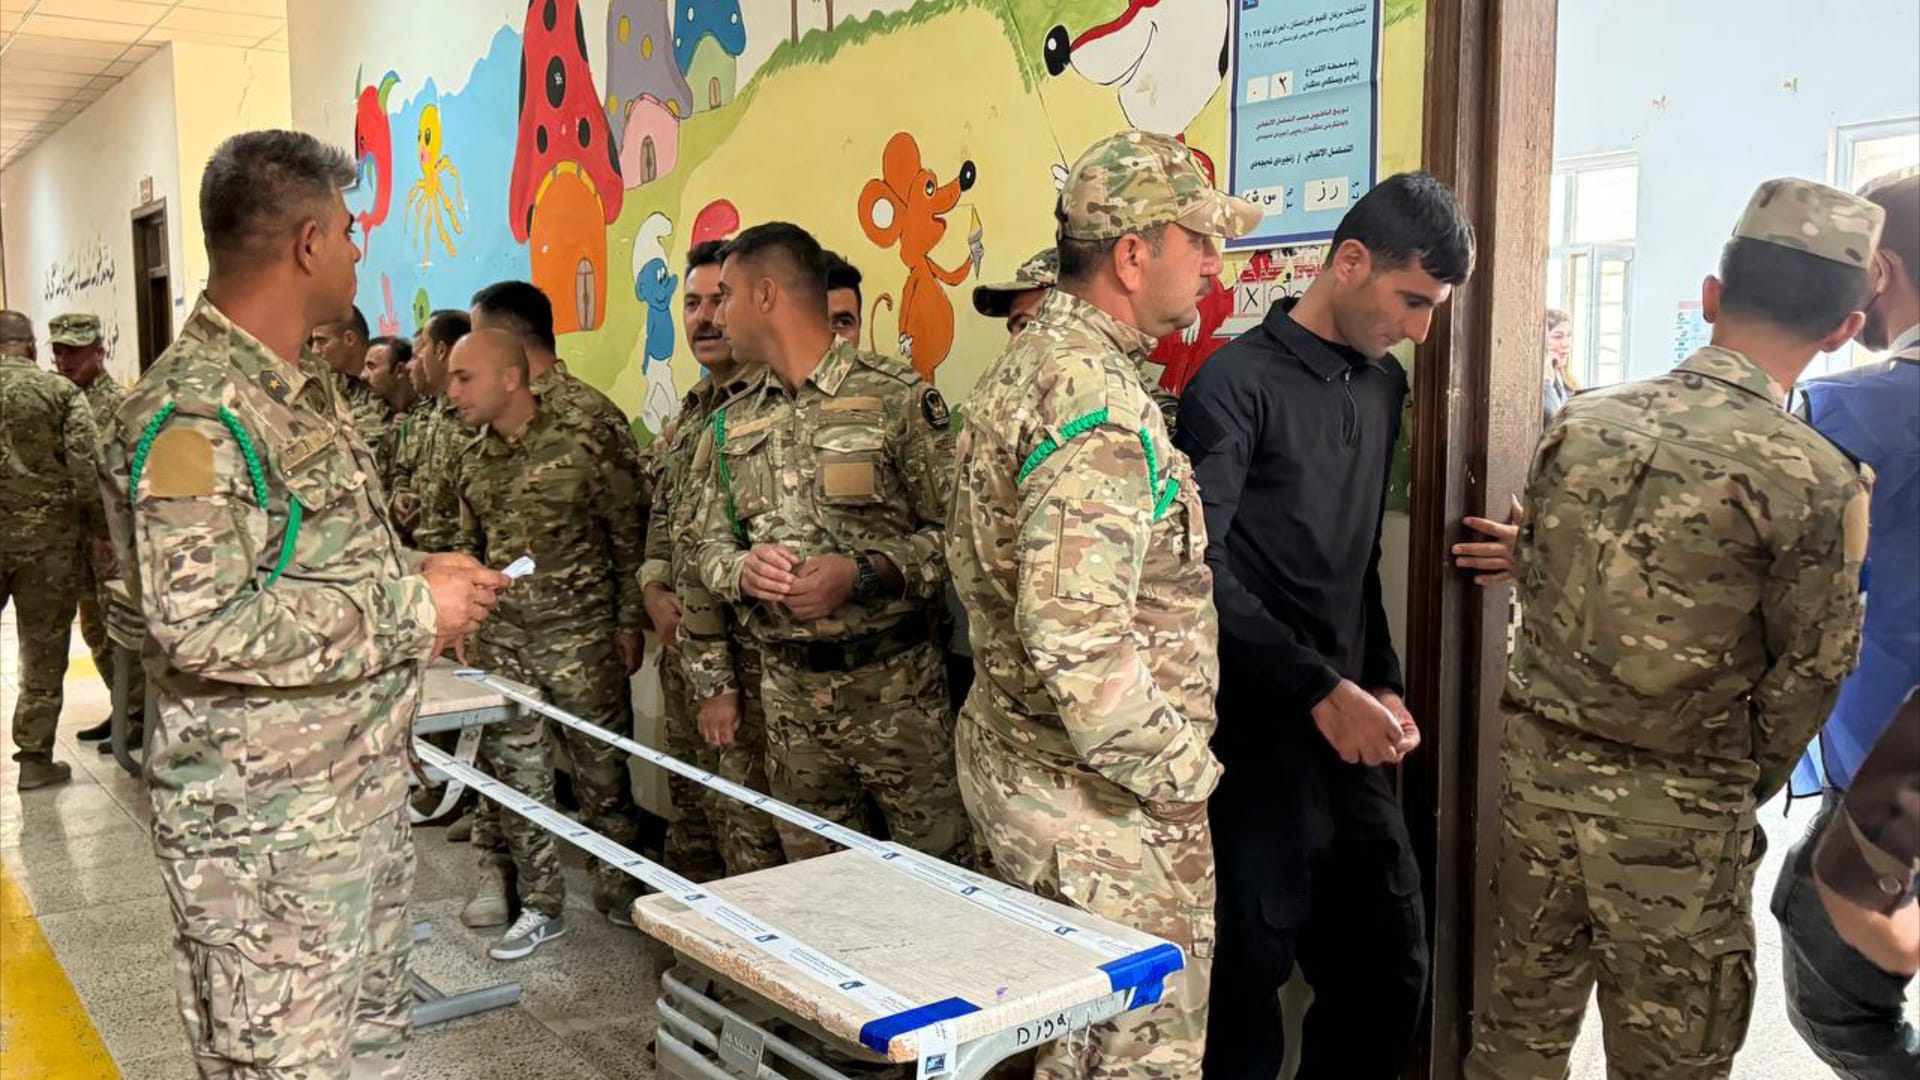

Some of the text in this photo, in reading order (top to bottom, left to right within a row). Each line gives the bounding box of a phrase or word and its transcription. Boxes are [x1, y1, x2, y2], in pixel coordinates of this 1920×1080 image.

[1304, 57, 1358, 77] رقم محطة الاقتراع
